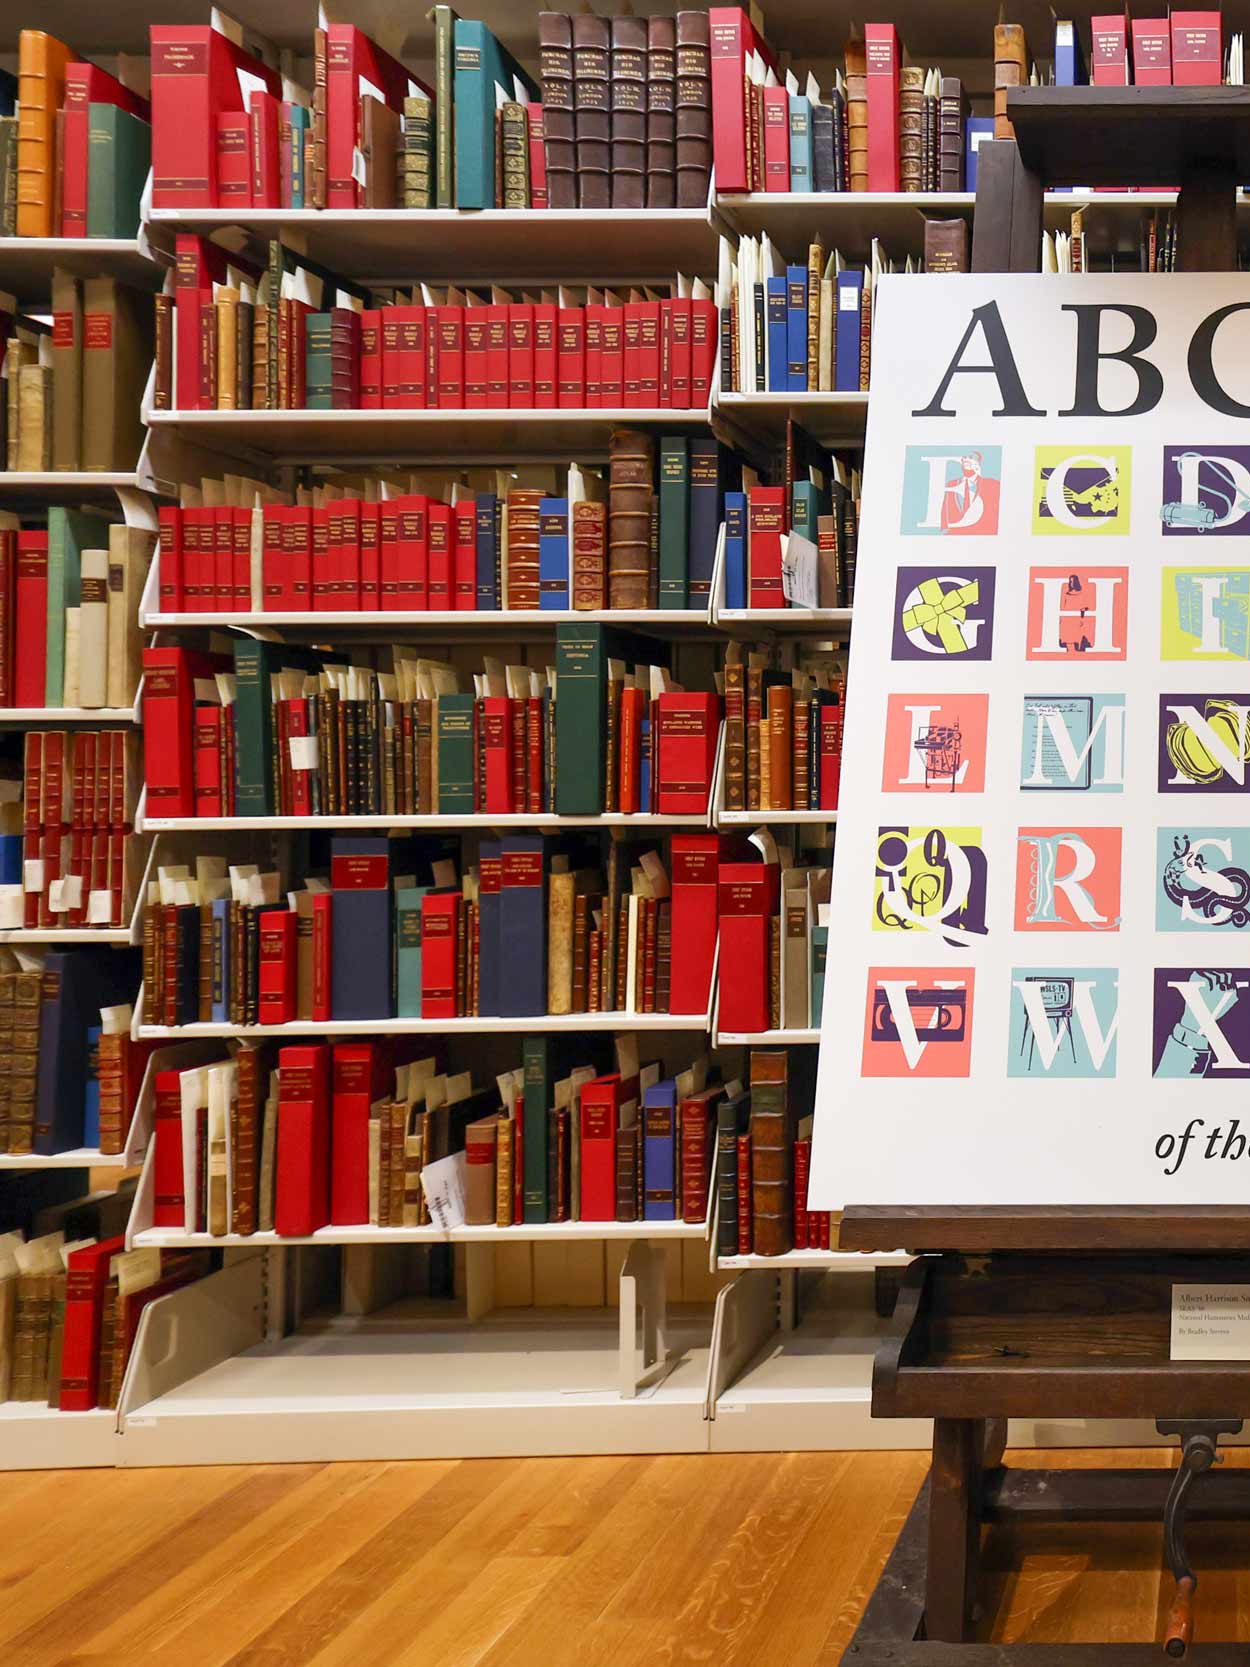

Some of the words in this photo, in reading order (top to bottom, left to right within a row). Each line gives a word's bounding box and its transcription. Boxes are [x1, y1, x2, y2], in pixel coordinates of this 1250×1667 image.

[1046, 455, 1117, 529] C
[1032, 577, 1122, 653] H
[1192, 577, 1229, 652] I
[898, 705, 969, 785] L
[1023, 705, 1126, 785] M
[1026, 838, 1109, 923] R
[876, 980, 966, 1070] V
[1013, 981, 1119, 1071] W
[1167, 981, 1250, 1069] X
[1155, 1119, 1205, 1175] of
[1180, 1294, 1203, 1303] Albert
[1205, 1294, 1239, 1303] Harrison
